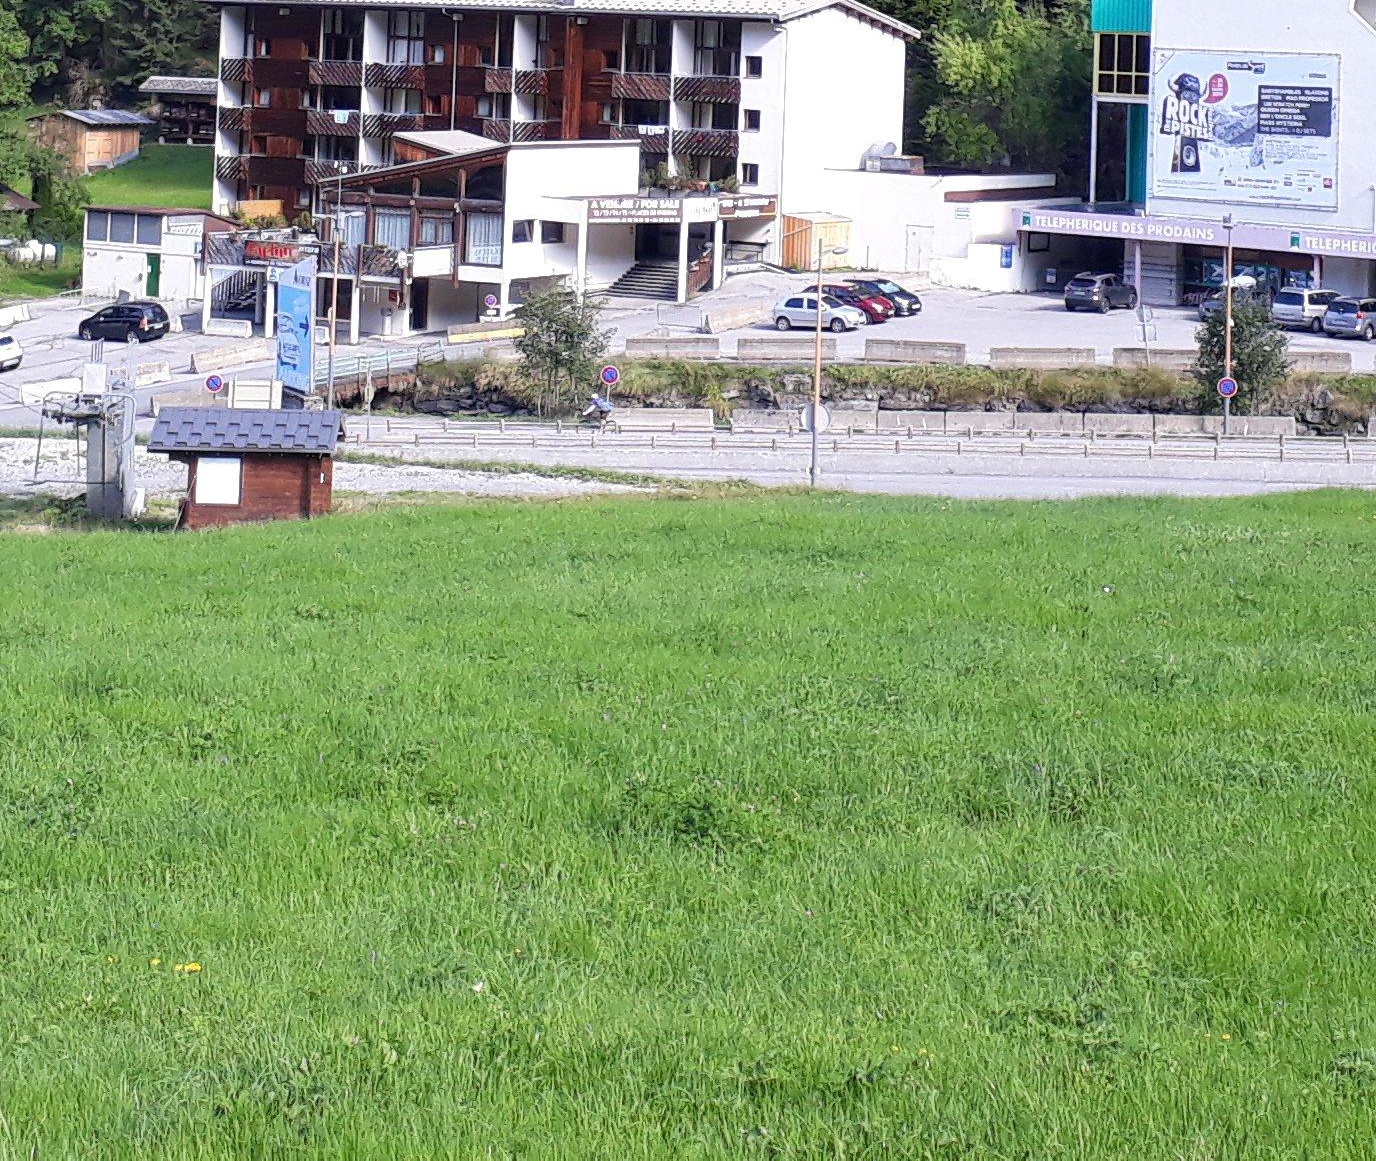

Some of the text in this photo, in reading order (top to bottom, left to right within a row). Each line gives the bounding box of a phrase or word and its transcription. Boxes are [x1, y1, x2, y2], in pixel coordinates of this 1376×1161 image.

[1165, 95, 1209, 128] ROCK
[1035, 215, 1215, 241] TELEPHERIQUE DES PRODAINS
